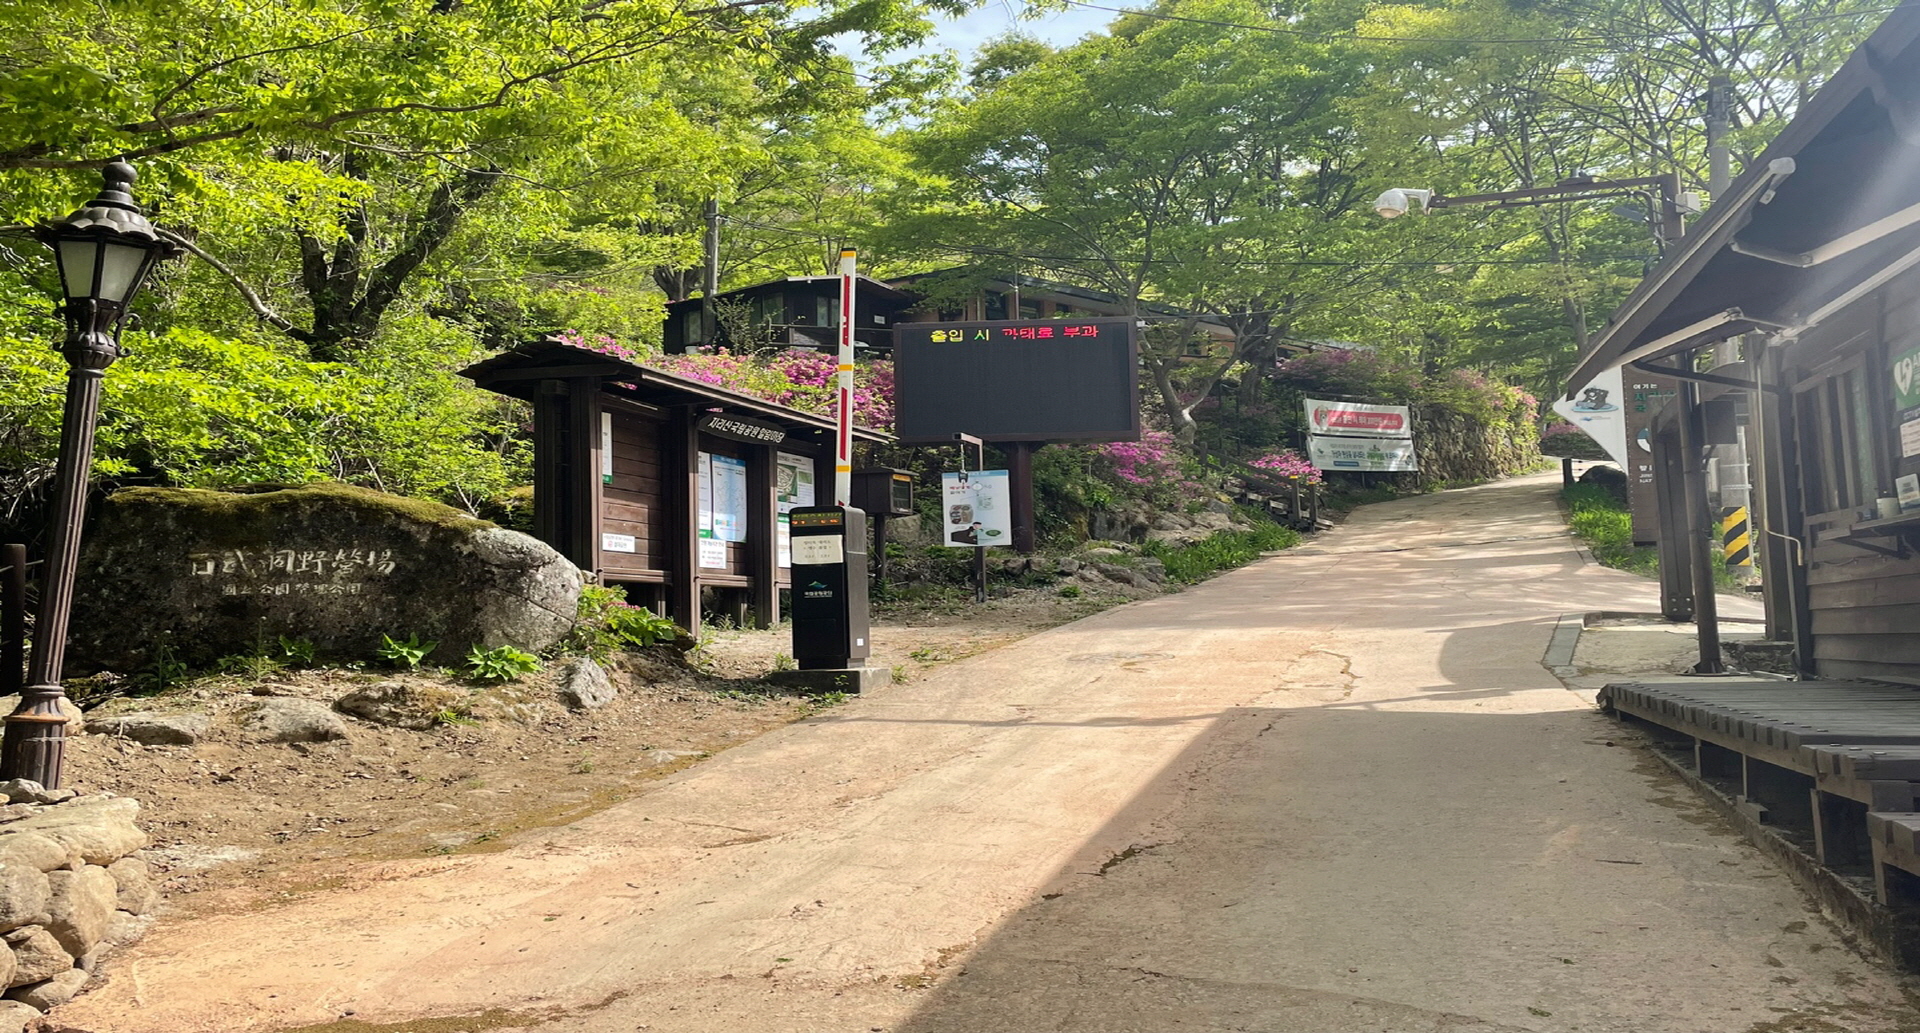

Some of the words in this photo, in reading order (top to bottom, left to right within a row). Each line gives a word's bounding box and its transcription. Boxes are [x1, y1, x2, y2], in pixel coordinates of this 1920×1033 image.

[930, 329, 964, 342] 출입
[973, 328, 990, 341] 시
[1063, 325, 1099, 338] 부과
[708, 417, 761, 438] 지리산국립공원
